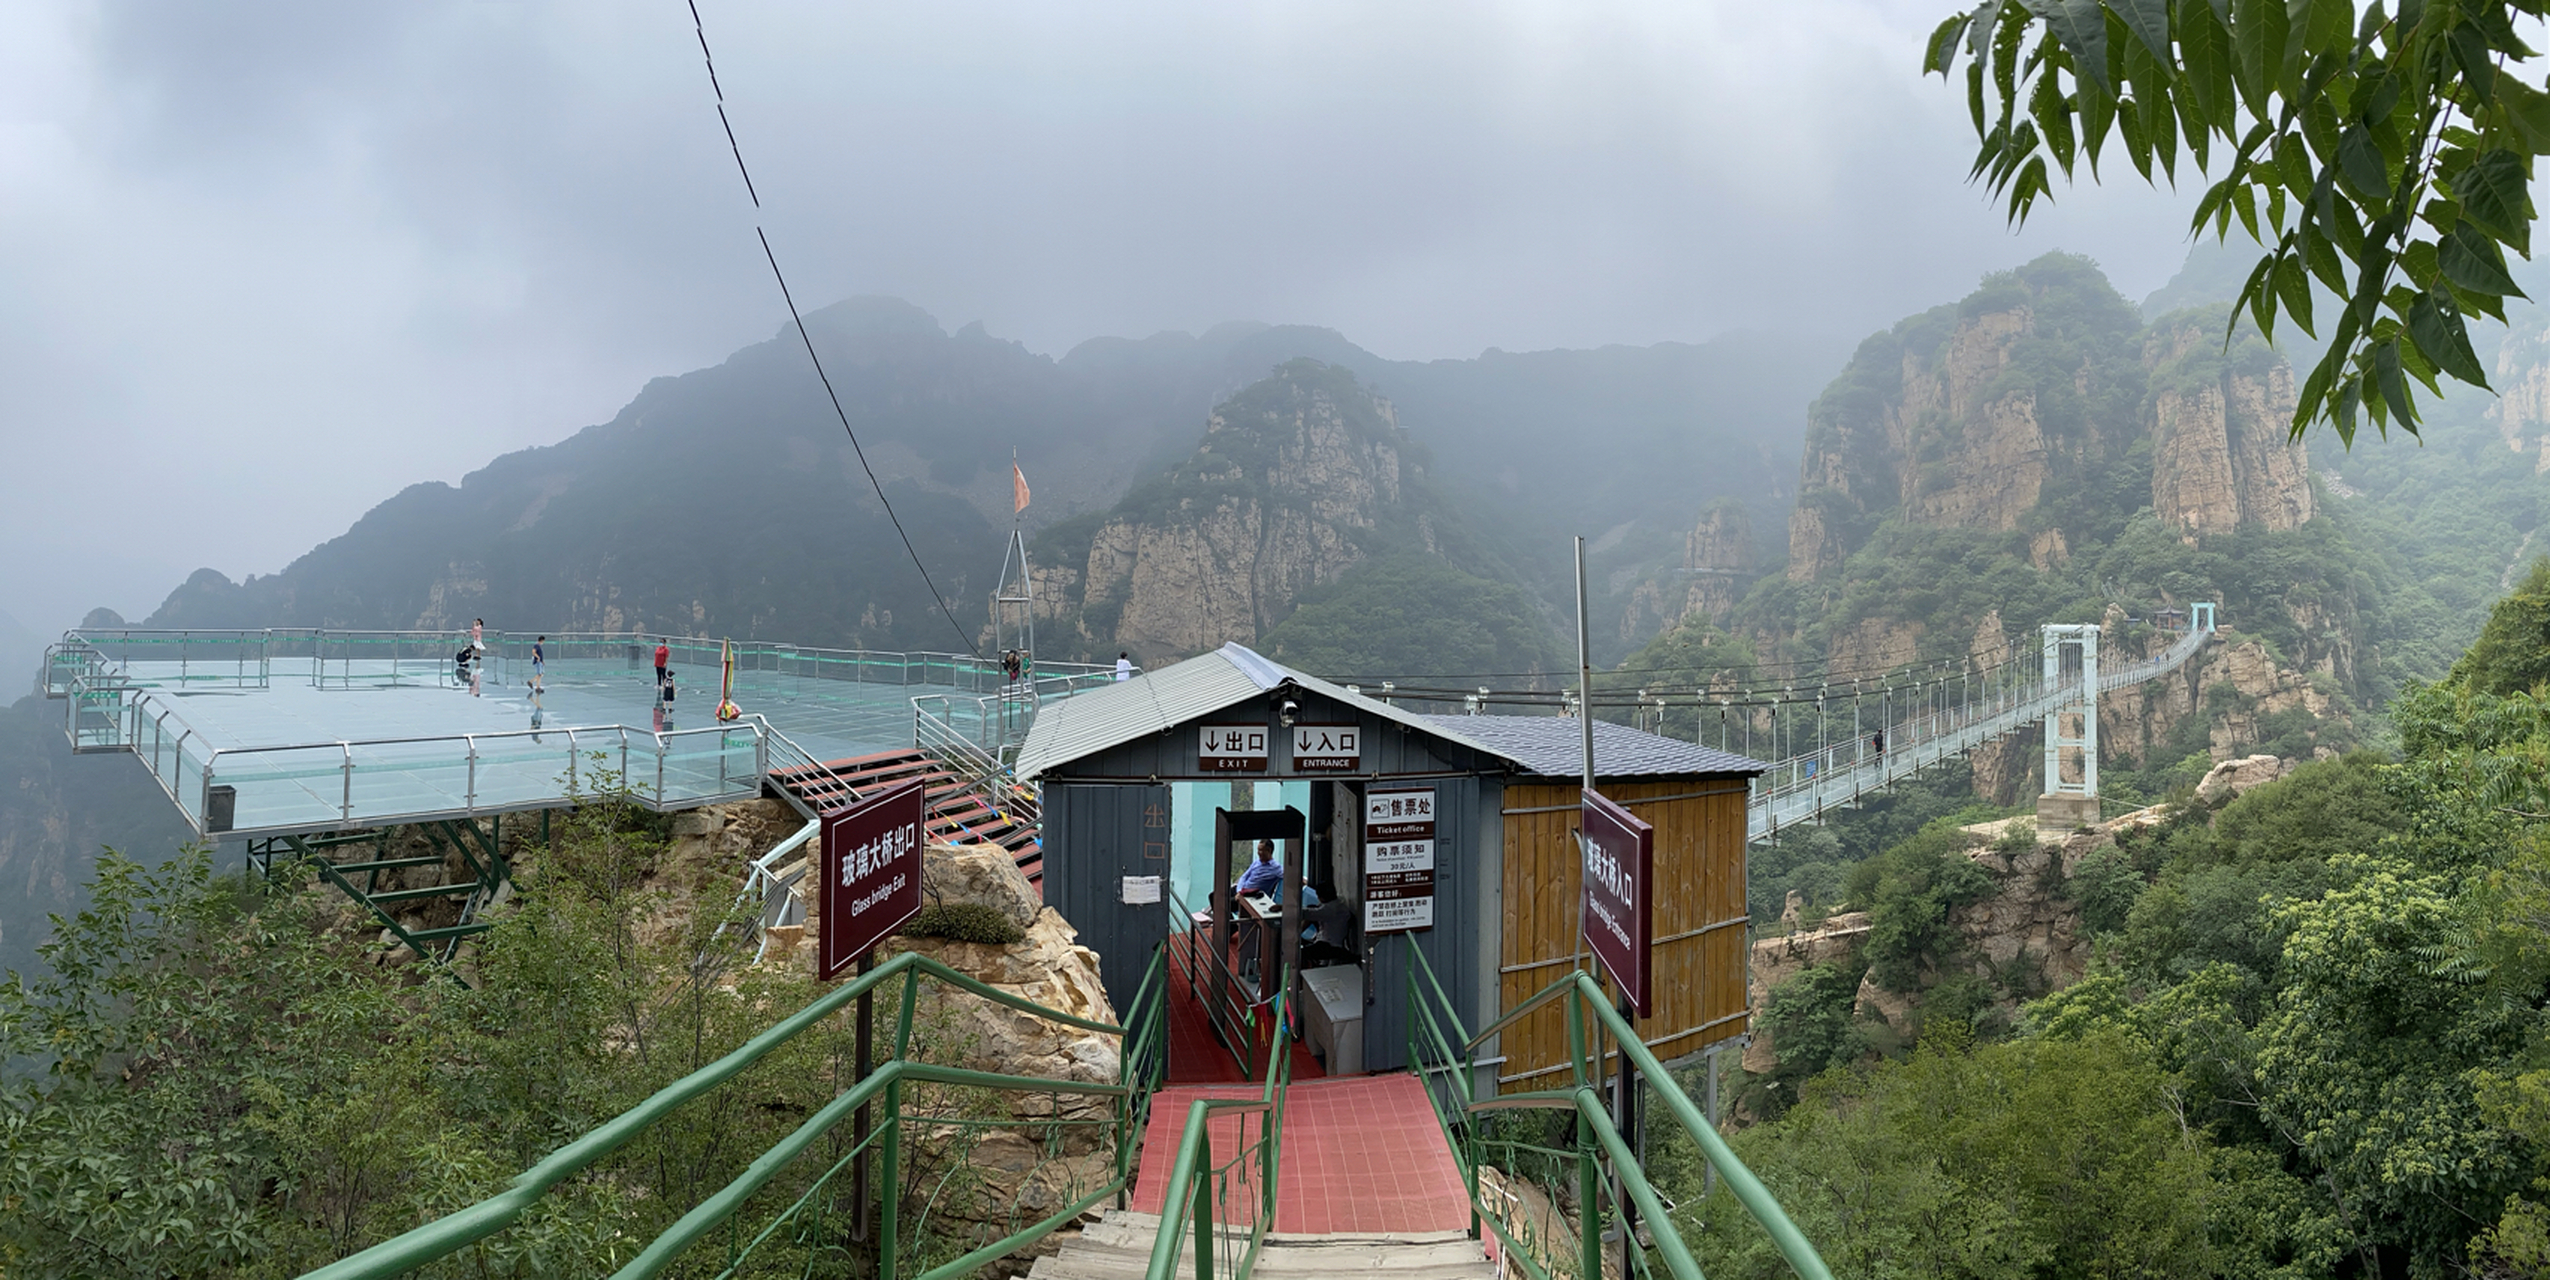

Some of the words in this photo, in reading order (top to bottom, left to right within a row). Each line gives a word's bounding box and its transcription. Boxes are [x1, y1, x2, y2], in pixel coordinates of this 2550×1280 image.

[1225, 731, 1264, 752] 出口
[1317, 732, 1355, 751] 入口
[1218, 759, 1249, 768] EXIT
[1303, 759, 1350, 768] ENTRANCE
[1391, 798, 1431, 817] 售票处
[1377, 826, 1402, 835] Ticket
[1402, 825, 1425, 833] office
[841, 822, 915, 888] 玻璃大桥出口
[1376, 844, 1425, 858] 购票须知
[1587, 837, 1632, 910] 玻璃大桥入口
[852, 896, 871, 917] Glass
[871, 884, 893, 905] bridge
[893, 873, 906, 891] Exit
